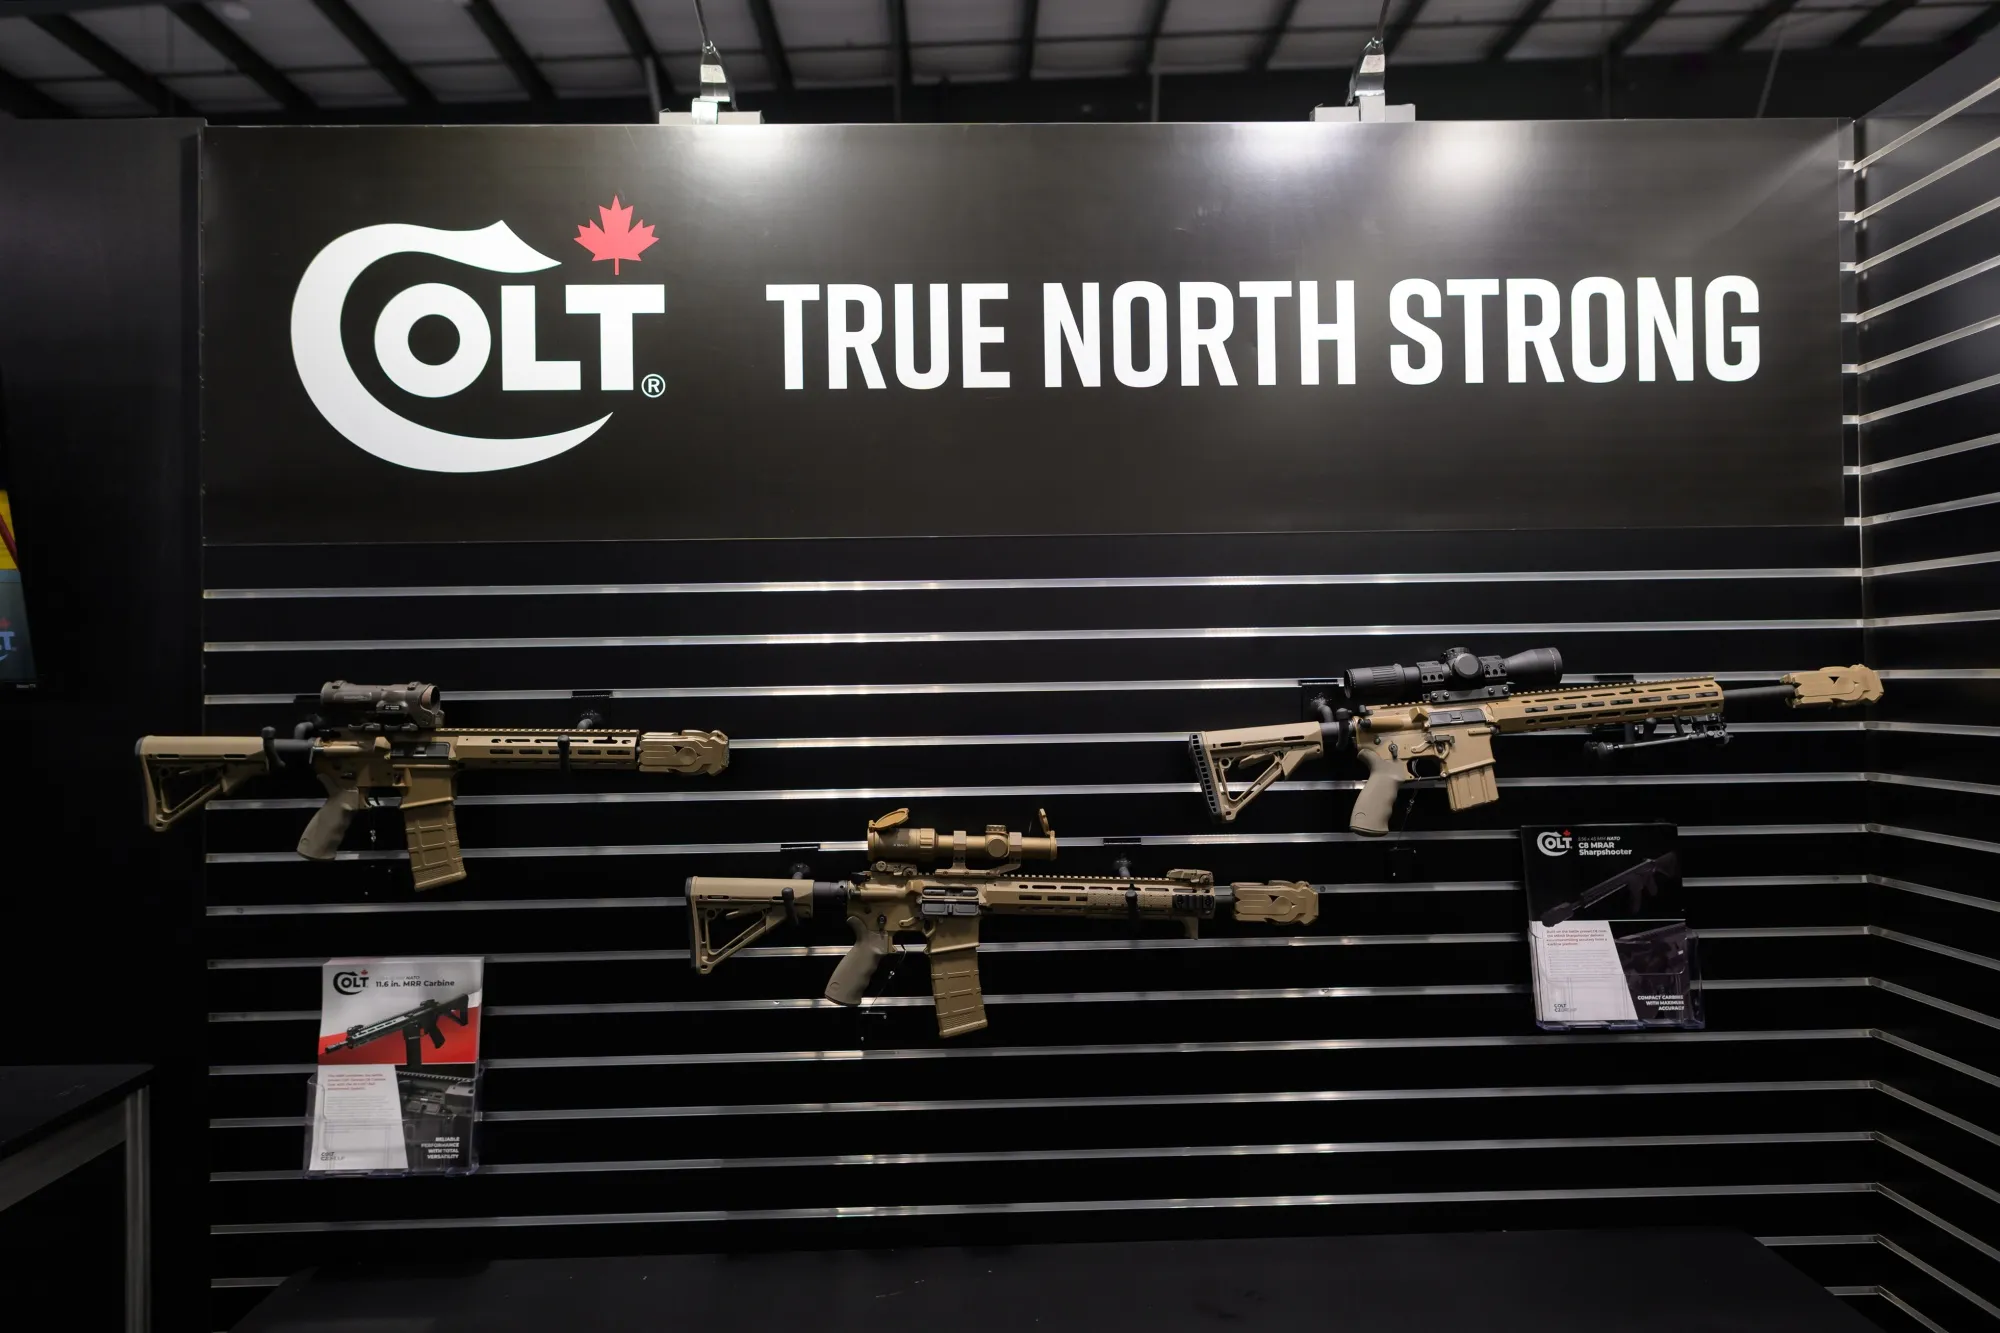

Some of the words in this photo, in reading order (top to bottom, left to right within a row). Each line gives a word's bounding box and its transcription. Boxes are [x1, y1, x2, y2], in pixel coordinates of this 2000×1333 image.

[765, 282, 1011, 390] TRUE
[1042, 279, 1356, 388] NORTH
[1388, 275, 1761, 386] STRONG
[1536, 831, 1573, 857] COLT
[1578, 841, 1589, 849] C8
[1590, 841, 1615, 849] MRAR
[1578, 848, 1633, 857] Sharpshooter
[332, 971, 369, 996] COLT
[376, 980, 389, 988] 11.6
[391, 980, 401, 988] in.
[423, 979, 455, 987] Carbine
